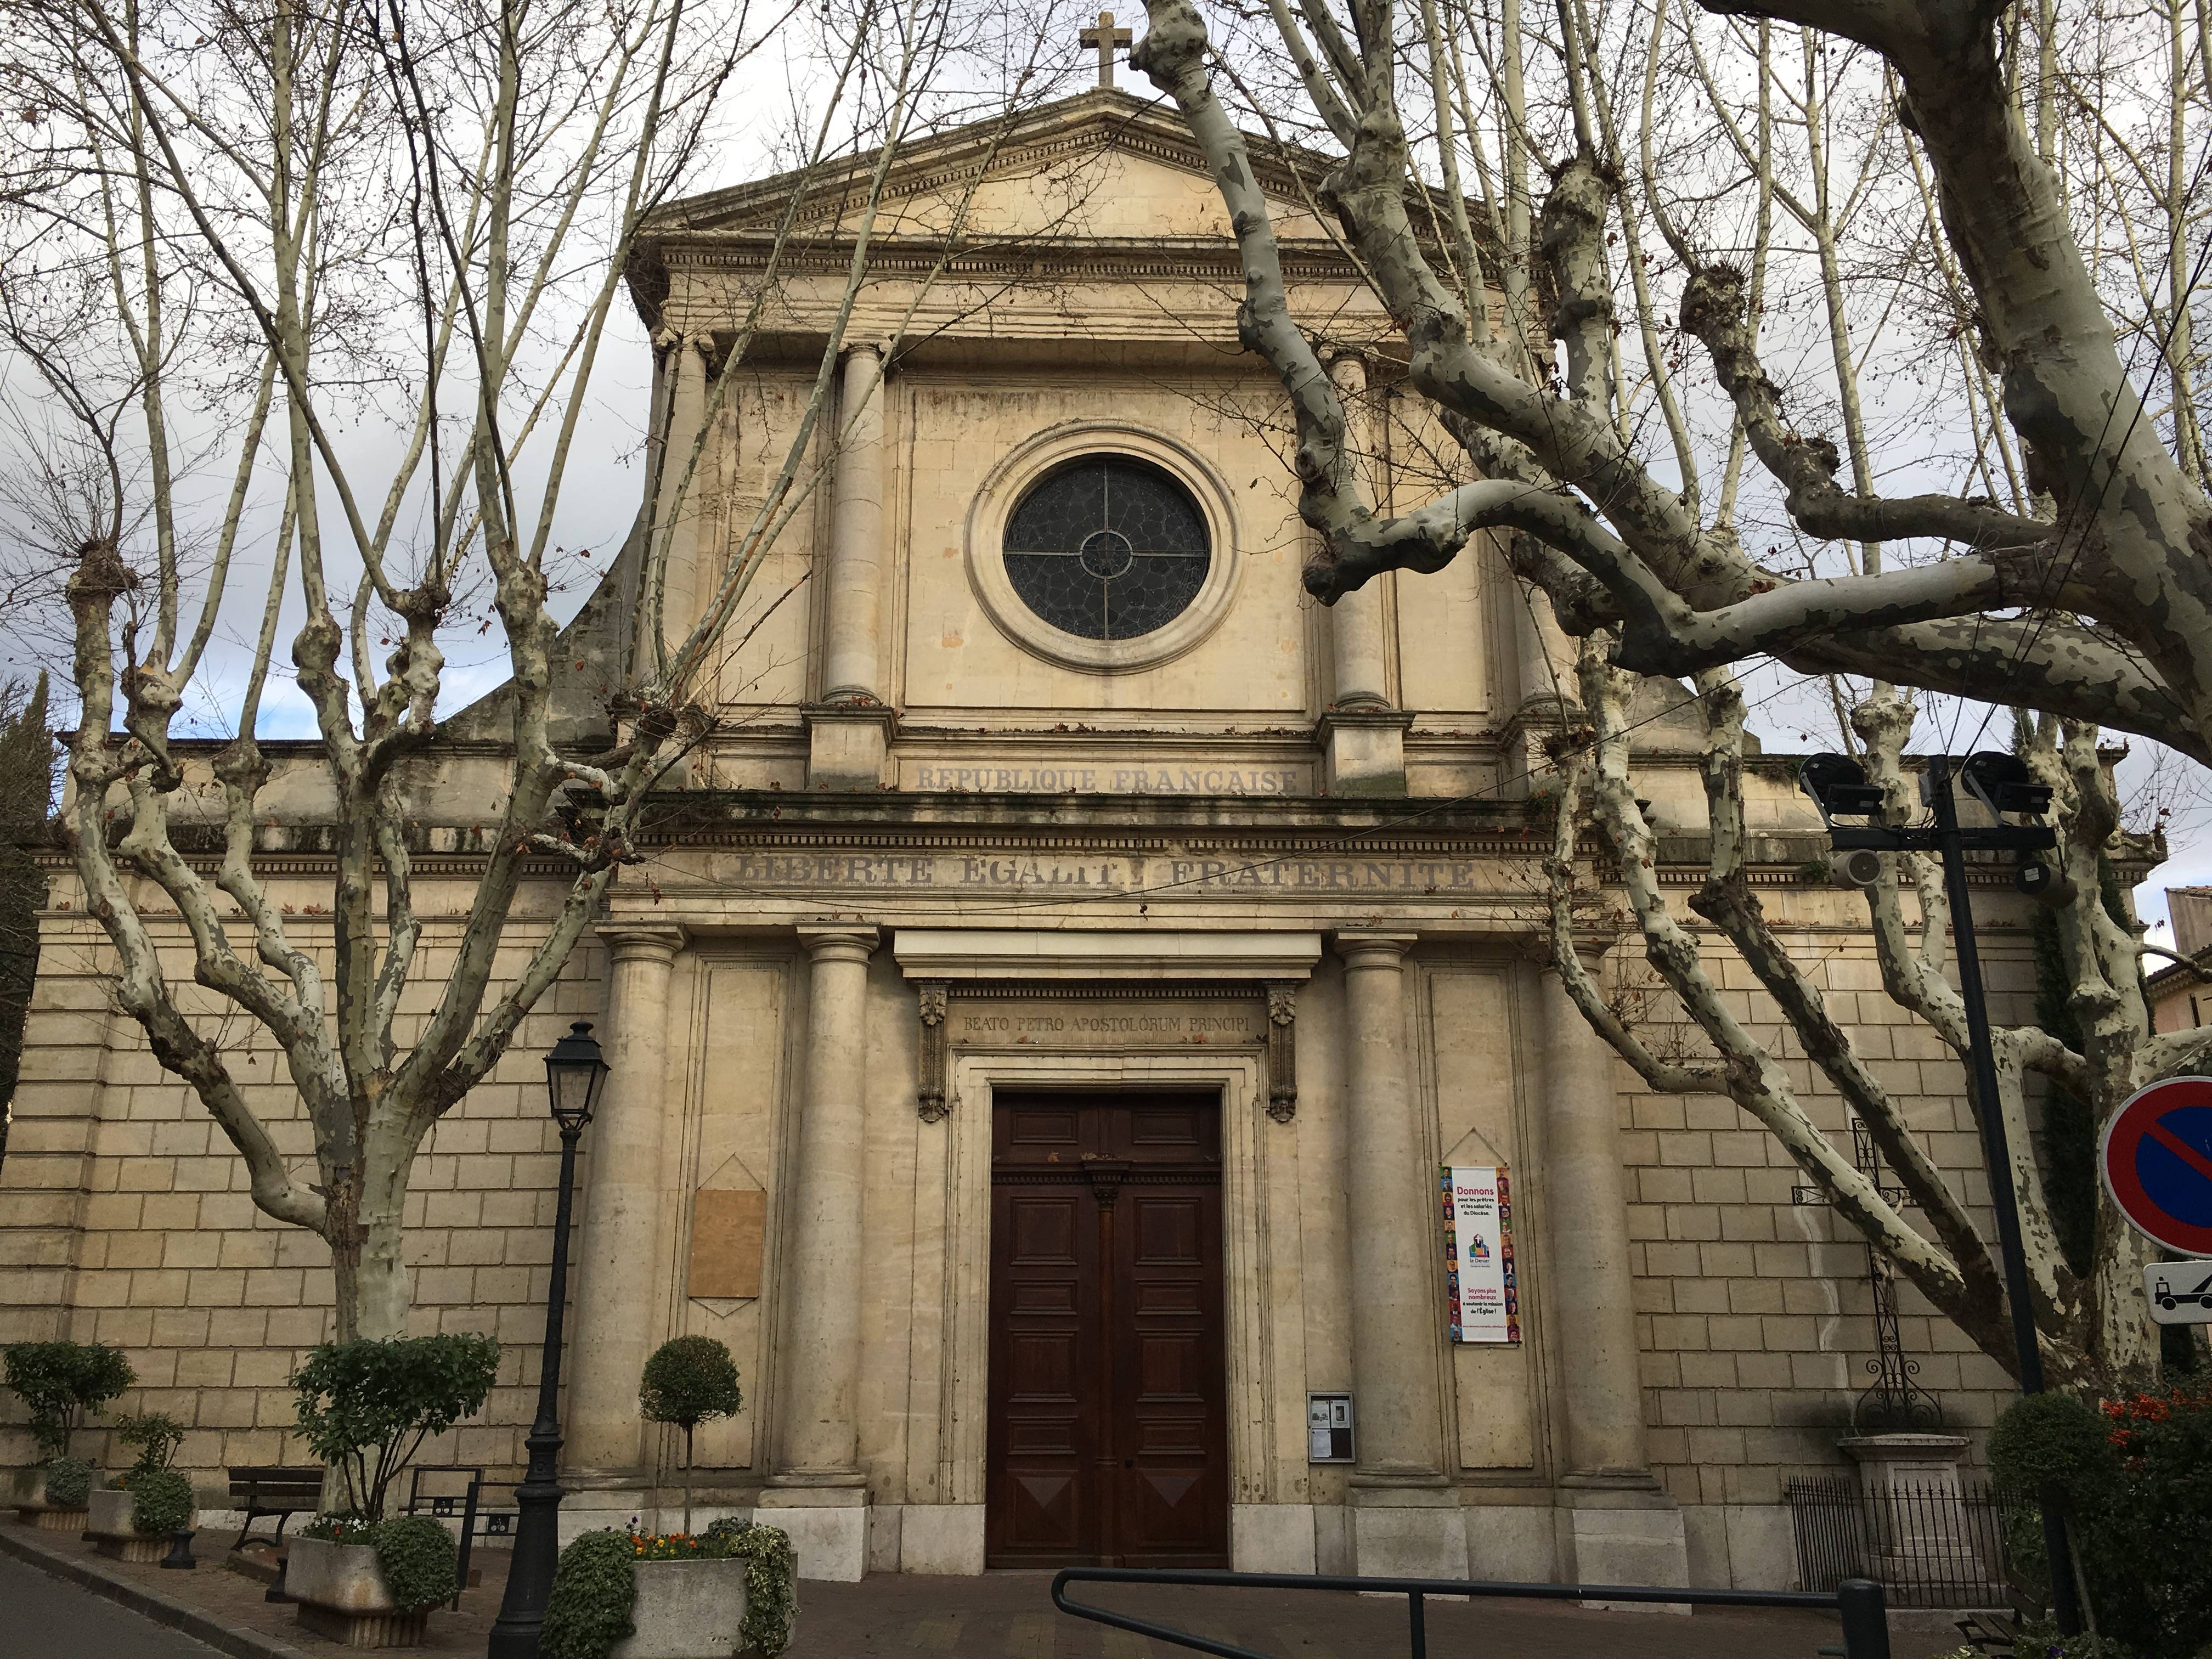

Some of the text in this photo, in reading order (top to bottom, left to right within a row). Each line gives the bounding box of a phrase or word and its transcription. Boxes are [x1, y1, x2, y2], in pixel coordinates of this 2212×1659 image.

[964, 1017, 1250, 1032] BEATO PETRO APOSTOLORUM PRINCIPI
[1457, 1186, 1494, 1195] Donnons
